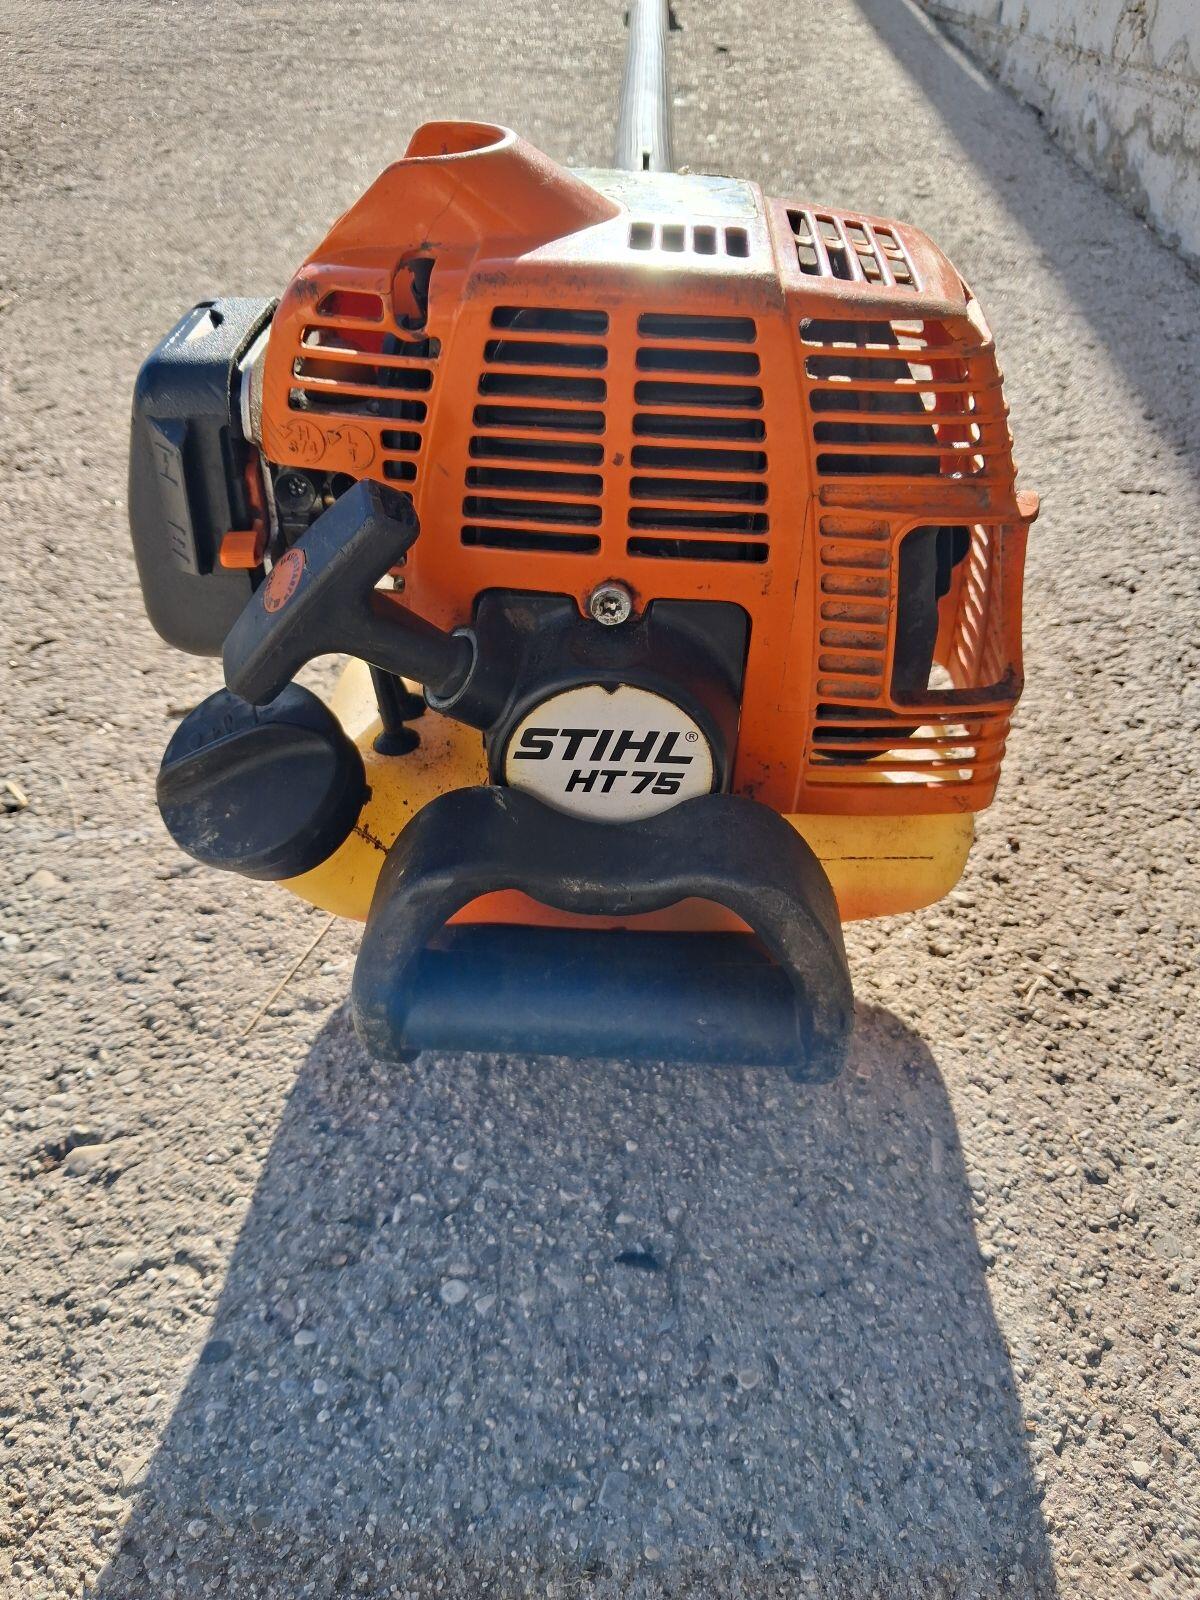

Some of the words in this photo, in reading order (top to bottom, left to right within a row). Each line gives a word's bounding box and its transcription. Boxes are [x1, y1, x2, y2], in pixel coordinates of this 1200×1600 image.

[513, 727, 694, 765] STIHL
[565, 769, 628, 794] HT
[630, 770, 686, 795] 75
